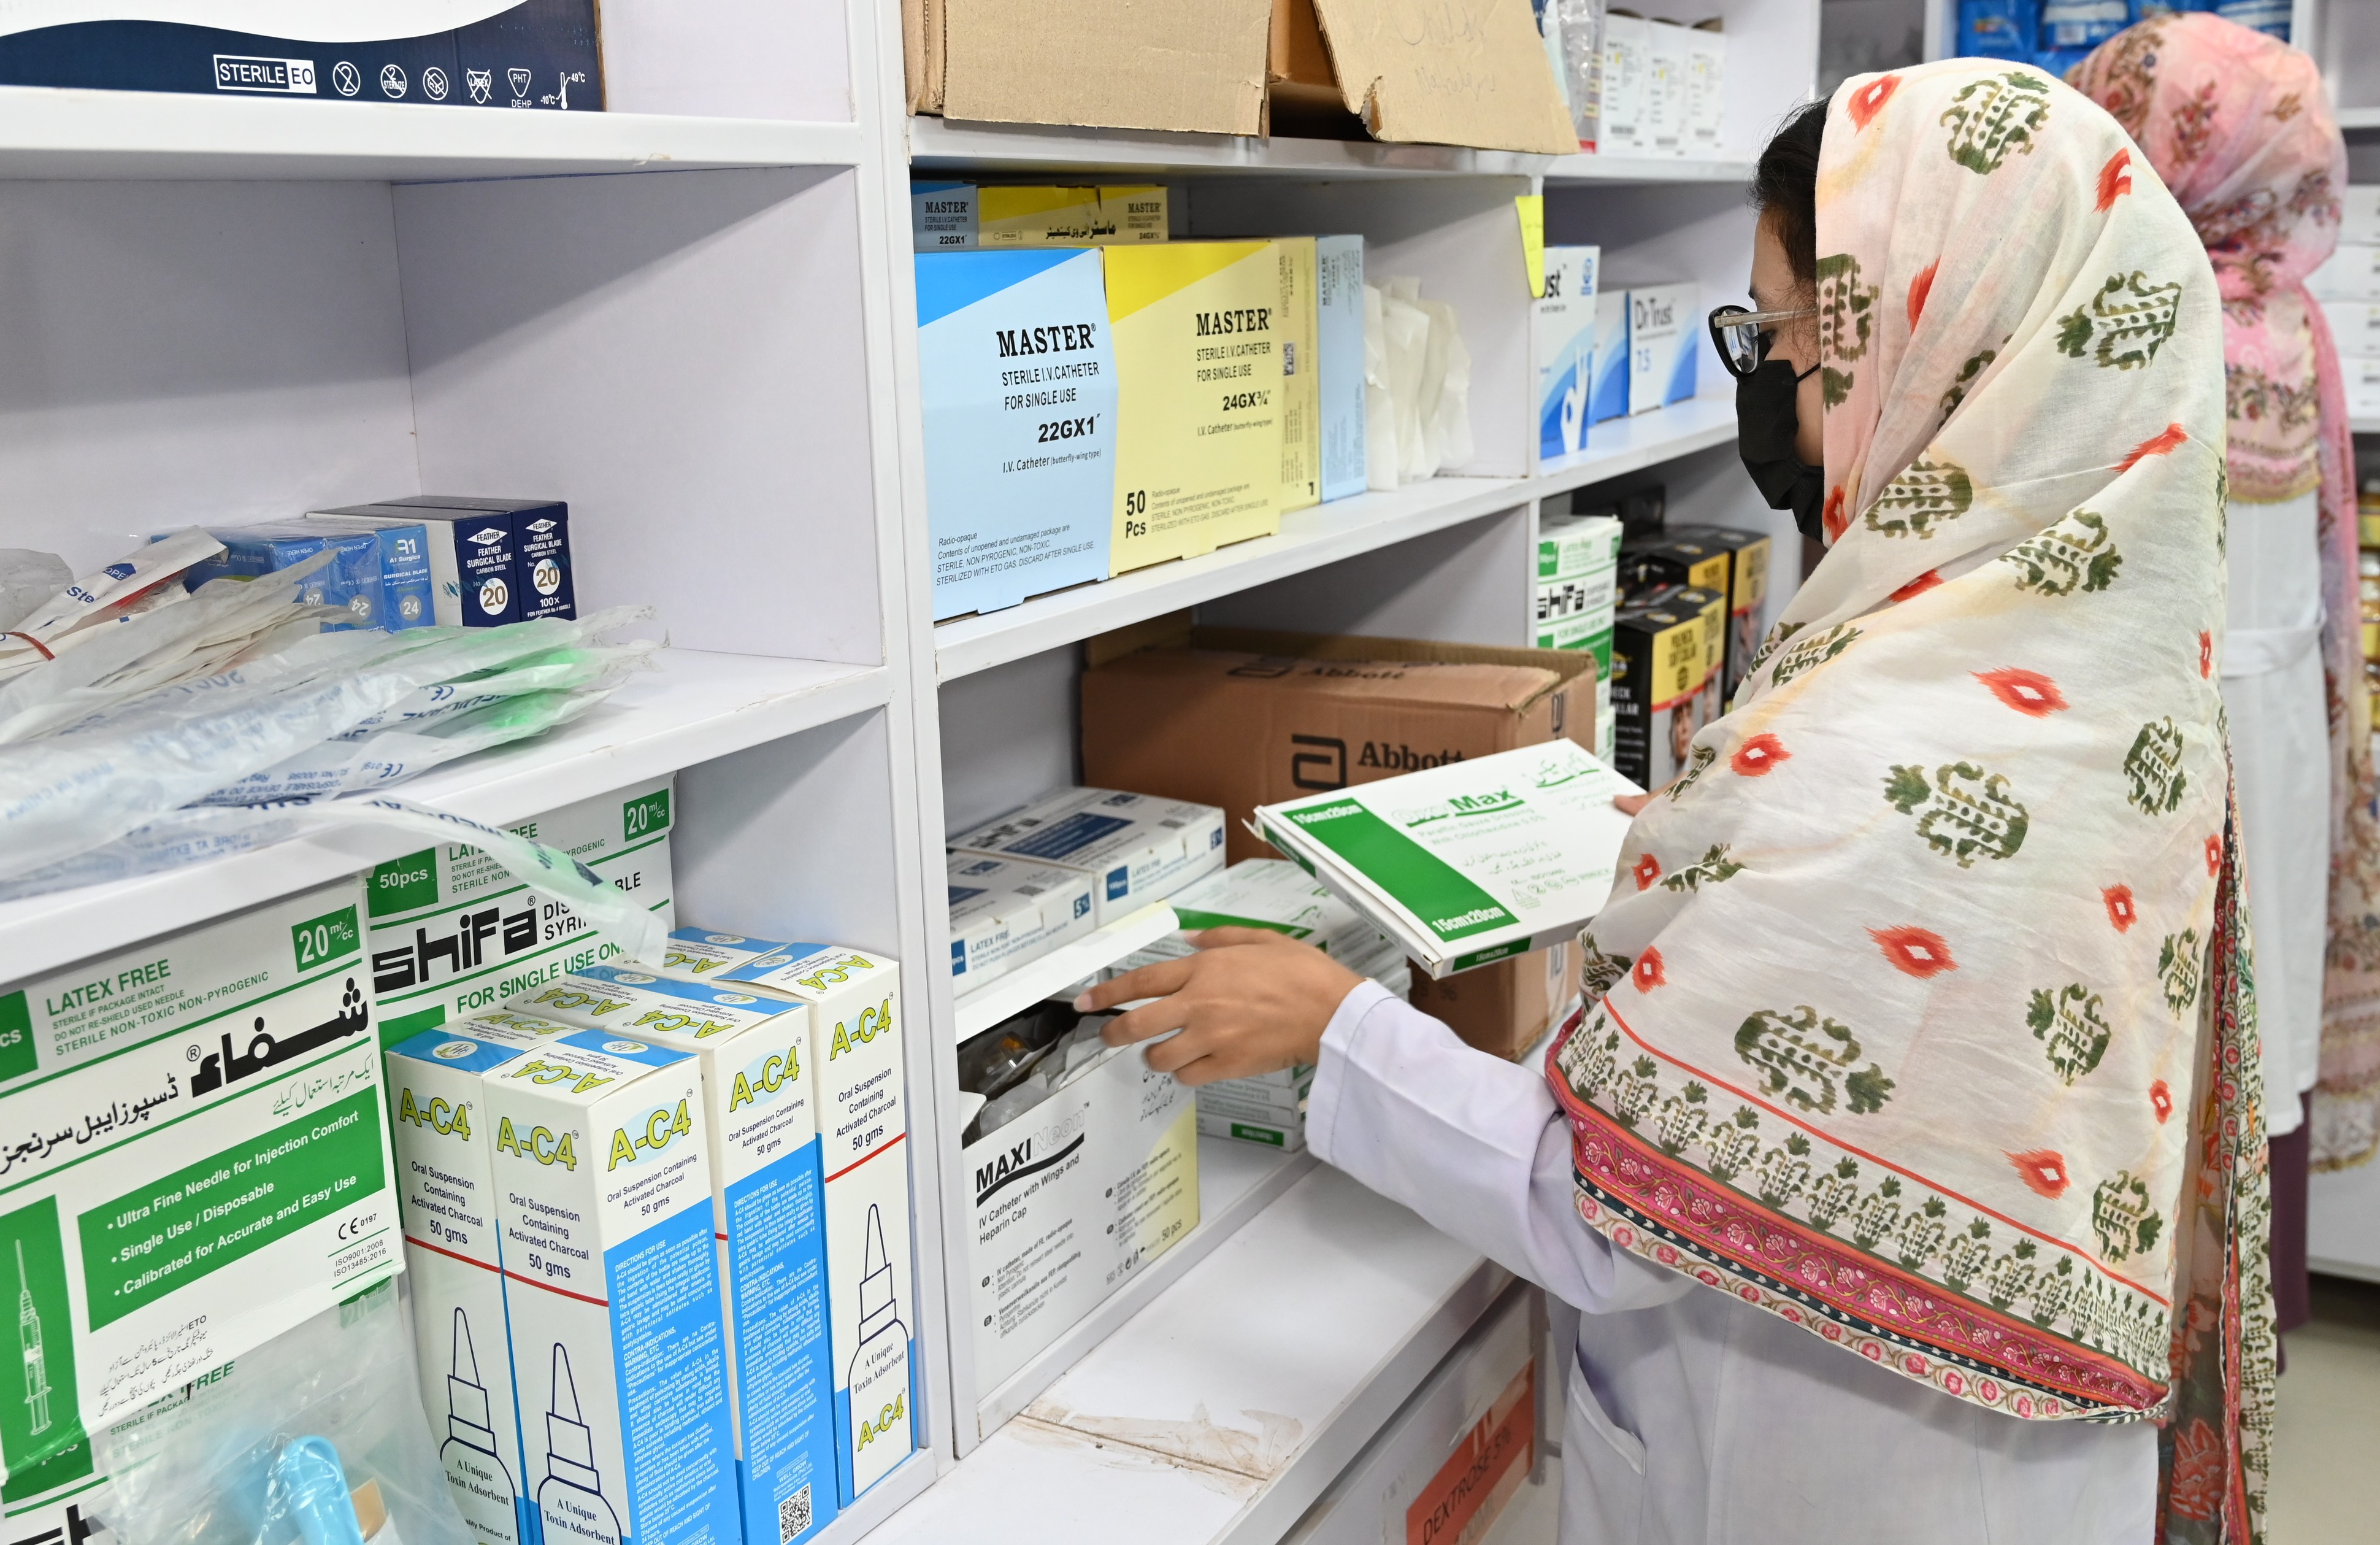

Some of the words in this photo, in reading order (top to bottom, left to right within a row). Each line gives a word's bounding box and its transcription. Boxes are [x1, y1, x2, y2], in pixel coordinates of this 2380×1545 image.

[220, 63, 286, 83] STERILE
[292, 68, 313, 85] EO
[384, 80, 405, 90] STERILIZE
[470, 78, 488, 87] LATEX
[513, 74, 527, 83] PHT
[571, 72, 585, 83] 49°C
[512, 99, 532, 108] DEHP
[925, 202, 967, 213] MASTER
[1128, 203, 1161, 213] MASTER
[1196, 309, 1269, 336] MASTER
[1636, 299, 1648, 330] Dr
[1649, 297, 1673, 326] Trust
[996, 324, 1094, 357] MASTER
[1197, 347, 1224, 361] STERILE
[1002, 369, 1040, 387] STERILE
[1005, 395, 1023, 410] FOR
[1026, 390, 1057, 408] SINGLE
[1060, 388, 1077, 403] USE
[1003, 461, 1014, 473] I.V.
[1016, 457, 1050, 471] Catheter
[1127, 490, 1145, 516] 50
[477, 531, 500, 542] FEATHER
[533, 533, 553, 542] FEATHER
[938, 549, 963, 560] Contents
[971, 541, 997, 554] unopened
[999, 537, 1009, 546] and
[1010, 531, 1039, 544] undamaged
[1040, 527, 1061, 538] package
[939, 532, 977, 546] Radio-opaque
[1126, 522, 1146, 539] Pcs
[478, 545, 501, 557] FEATHER
[524, 542, 547, 552] SURGICAL
[548, 539, 562, 548] BLADE
[467, 557, 495, 568] SURGICAL
[496, 553, 512, 562] BLADE
[477, 566, 494, 575] CARBON
[937, 571, 972, 585] STERILIZED
[973, 565, 989, 577] WITH
[991, 564, 1002, 573] ETO
[1019, 554, 1043, 566] DISCARD
[1045, 549, 1062, 560] AFTER
[1063, 544, 1081, 555] SINGLE
[967, 557, 980, 566] NON
[536, 567, 558, 588] 20
[351, 599, 369, 616] 24
[404, 602, 418, 615] 24
[483, 586, 505, 607] 20
[628, 804, 647, 834] 20
[380, 869, 428, 888] 50pcs
[299, 925, 329, 963] 20
[971, 936, 994, 952] LATEX
[47, 979, 113, 1016] LATEX
[118, 959, 171, 992] FREE
[458, 987, 494, 1014] FOR
[501, 963, 559, 999] SINGLE
[564, 949, 594, 974] USE
[53, 1012, 87, 1030] STERILE
[88, 1009, 96, 1017] IF
[98, 995, 136, 1014] PACKAGE
[138, 985, 164, 1000] INTACT
[55, 1031, 67, 1041] DO
[69, 1024, 86, 1037] NOT
[88, 1009, 130, 1029] RE-SHIELD
[132, 1001, 153, 1014] USED
[155, 990, 185, 1005] NEEDLE
[56, 1032, 106, 1055] STERILE
[110, 1006, 175, 1036] NON-TOXIC
[179, 972, 269, 1011] NON-PYROGENIC
[830, 998, 891, 1061] A-C4
[355, 1053, 374, 1080] ایک
[729, 1046, 799, 1113] A-C4
[296, 1077, 332, 1108] استعمال
[332, 1070, 355, 1093] مرتبہ
[839, 1087, 853, 1103] Oral
[854, 1068, 891, 1093] Suspension
[849, 1088, 883, 1114] Containing
[400, 1088, 470, 1141] A-C4
[836, 1115, 867, 1138] Activated
[869, 1096, 896, 1124] Charcoal
[497, 1117, 577, 1171] A-C4
[608, 1098, 691, 1172] A-C4
[853, 1135, 863, 1150] 50
[866, 1125, 883, 1147] gms
[117, 1207, 150, 1229] Ultra
[153, 1190, 182, 1213] Fine
[185, 1167, 231, 1198] Needle
[233, 1160, 252, 1176] for
[255, 1134, 308, 1166] Injection
[311, 1110, 359, 1140] Comfort
[607, 1190, 621, 1203] Oral
[623, 1172, 662, 1196] Suspension
[663, 1154, 697, 1175] Containing
[624, 1188, 654, 1209] Activated
[656, 1173, 685, 1192] Charcoal
[979, 1216, 986, 1229] IV
[989, 1195, 1021, 1222] Catheter
[1024, 1182, 1039, 1198] with
[1041, 1167, 1064, 1187] Wings
[1066, 1154, 1079, 1169] and
[642, 1204, 650, 1216] 50
[653, 1196, 670, 1212] gms
[120, 1233, 163, 1264] Single
[167, 1219, 192, 1239] Use
[202, 1181, 275, 1223] Disposable
[361, 1213, 377, 1227] 0197
[980, 1219, 1010, 1245] Heparin
[1012, 1207, 1027, 1223] Cap
[124, 1251, 192, 1295] Calibrated
[196, 1242, 214, 1259] for
[217, 1215, 273, 1250] Accurate
[276, 1200, 299, 1220] and
[302, 1187, 331, 1209] Easy
[334, 1174, 357, 1193] Use
[334, 1248, 386, 1277] ISO13485:2016
[336, 1239, 383, 1266] ISO9001:2008
[615, 1252, 645, 1272] DIRECTIONS
[645, 1245, 655, 1255] FOR
[656, 1239, 666, 1250] USE
[189, 1315, 206, 1330] ETO
[865, 1359, 870, 1370] A
[872, 1343, 894, 1364] Unique
[853, 1376, 872, 1394] Toxin
[873, 1351, 904, 1381] Adsorbent
[858, 1393, 904, 1452] A-C4
[752, 1464, 762, 1474] KEEP
[775, 1447, 786, 1460] REACH
[795, 1434, 805, 1446] SIGHT
[457, 1458, 463, 1470] A
[464, 1462, 493, 1481] Unique
[779, 1472, 792, 1483] WELL
[793, 1460, 807, 1473] GROW
[445, 1470, 466, 1489] Toxin
[468, 1483, 509, 1506] Adsorbent
[480, 1524, 500, 1539] Product
